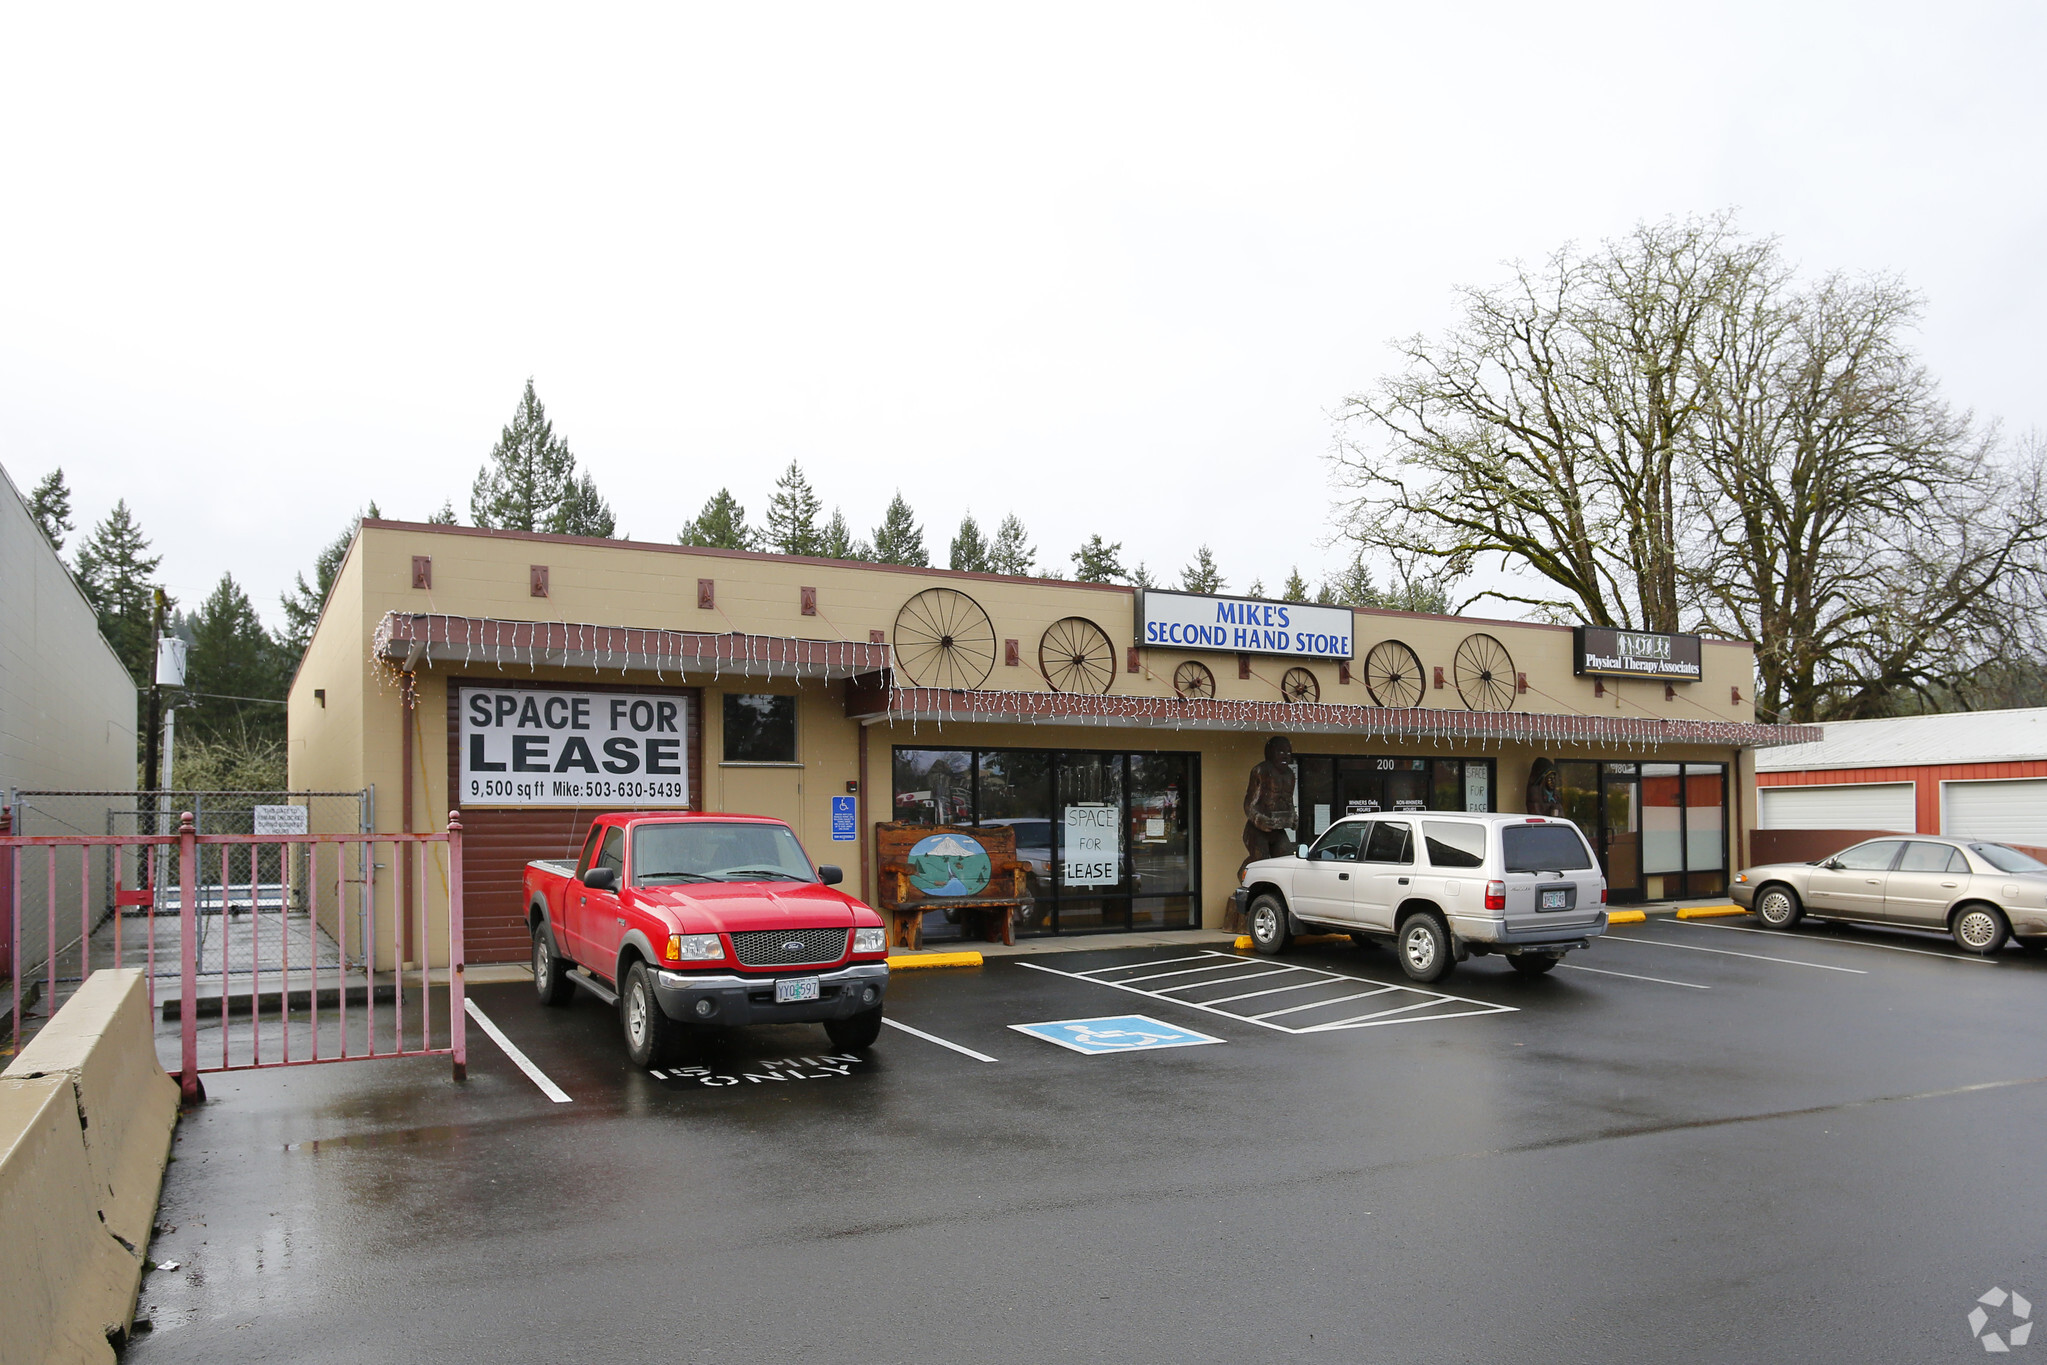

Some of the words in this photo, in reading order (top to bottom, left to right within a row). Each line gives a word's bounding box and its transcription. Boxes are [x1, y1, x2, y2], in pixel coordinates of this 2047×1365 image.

[1216, 602, 1290, 628] MIKE'S
[1147, 621, 1227, 646] SECOND
[1234, 628, 1290, 650] HAND
[1296, 633, 1349, 655] STORE
[1585, 653, 1621, 669] Physical
[1623, 656, 1658, 674] Therapy
[1658, 659, 1700, 674] Associates
[469, 693, 590, 730] SPACE
[610, 699, 678, 733] FOR
[470, 734, 681, 775] LEASE
[1376, 759, 1395, 770] 200
[1466, 767, 1487, 780] SPACE
[471, 780, 513, 797] 9,500
[517, 783, 531, 799] sq
[535, 781, 544, 796] ft
[553, 781, 583, 797] Mike:
[586, 782, 682, 798] 503-630-5439
[1470, 785, 1485, 797] FOR
[1067, 809, 1114, 827] SPACE
[1080, 838, 1102, 851] FOR
[1067, 863, 1112, 879] LEASE
[800, 982, 817, 996] 597
[759, 1053, 863, 1070] MIN
[699, 1064, 851, 1087] ONLY
